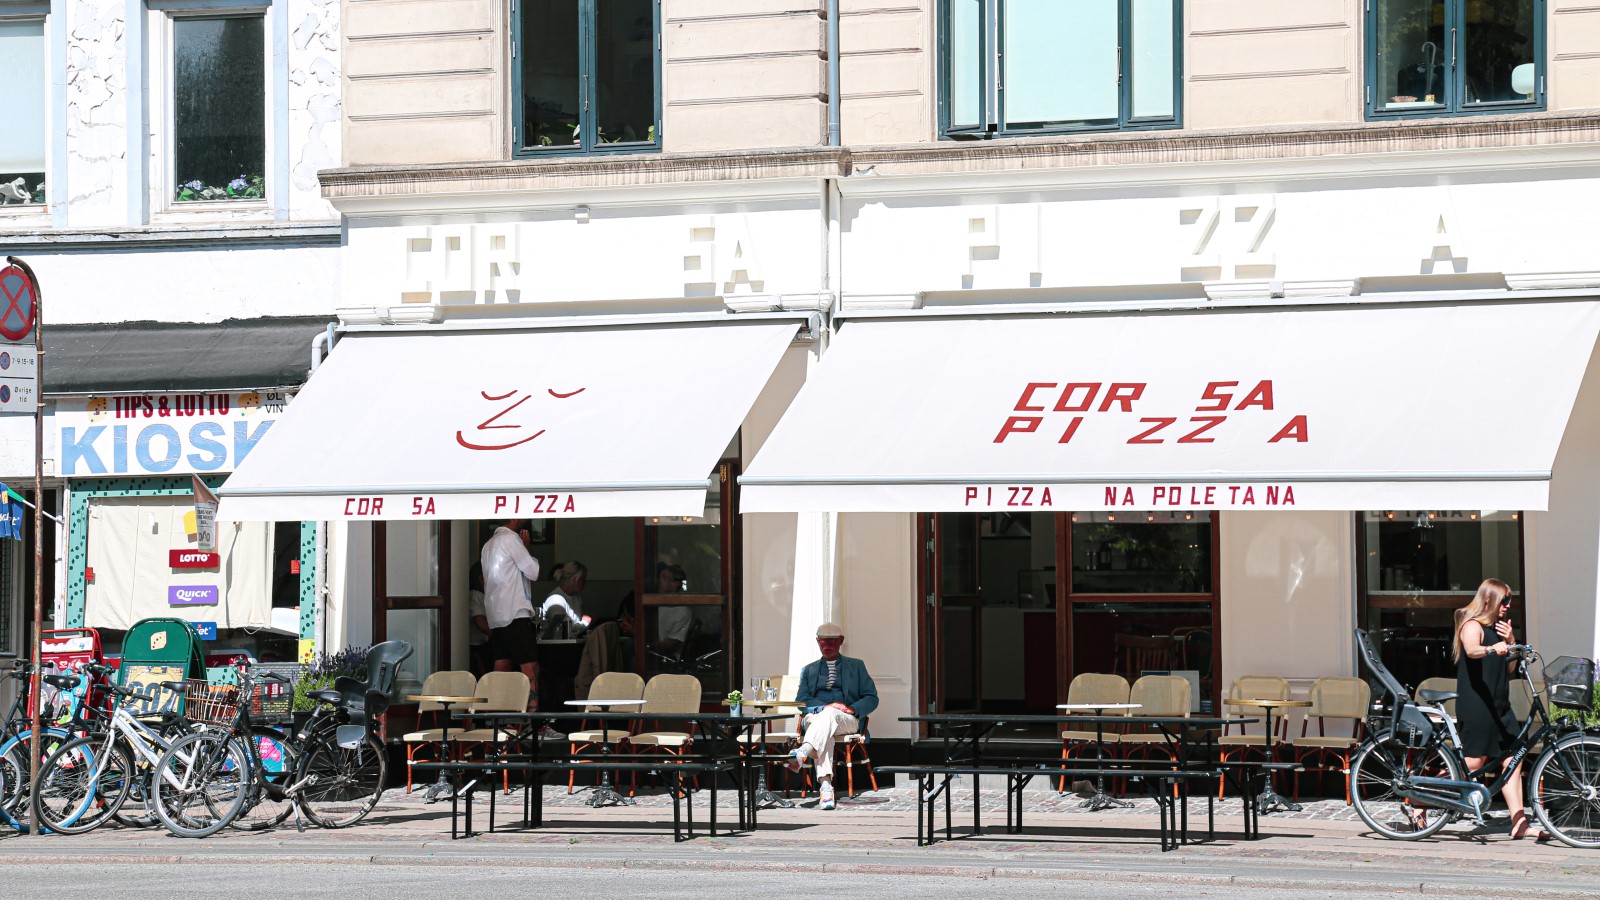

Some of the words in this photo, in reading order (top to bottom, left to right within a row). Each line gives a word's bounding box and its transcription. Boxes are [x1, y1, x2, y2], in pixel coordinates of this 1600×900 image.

[113, 396, 154, 419] TIPS
[158, 395, 171, 418] &
[265, 403, 284, 414] VIN
[179, 554, 209, 563] LOTTO
